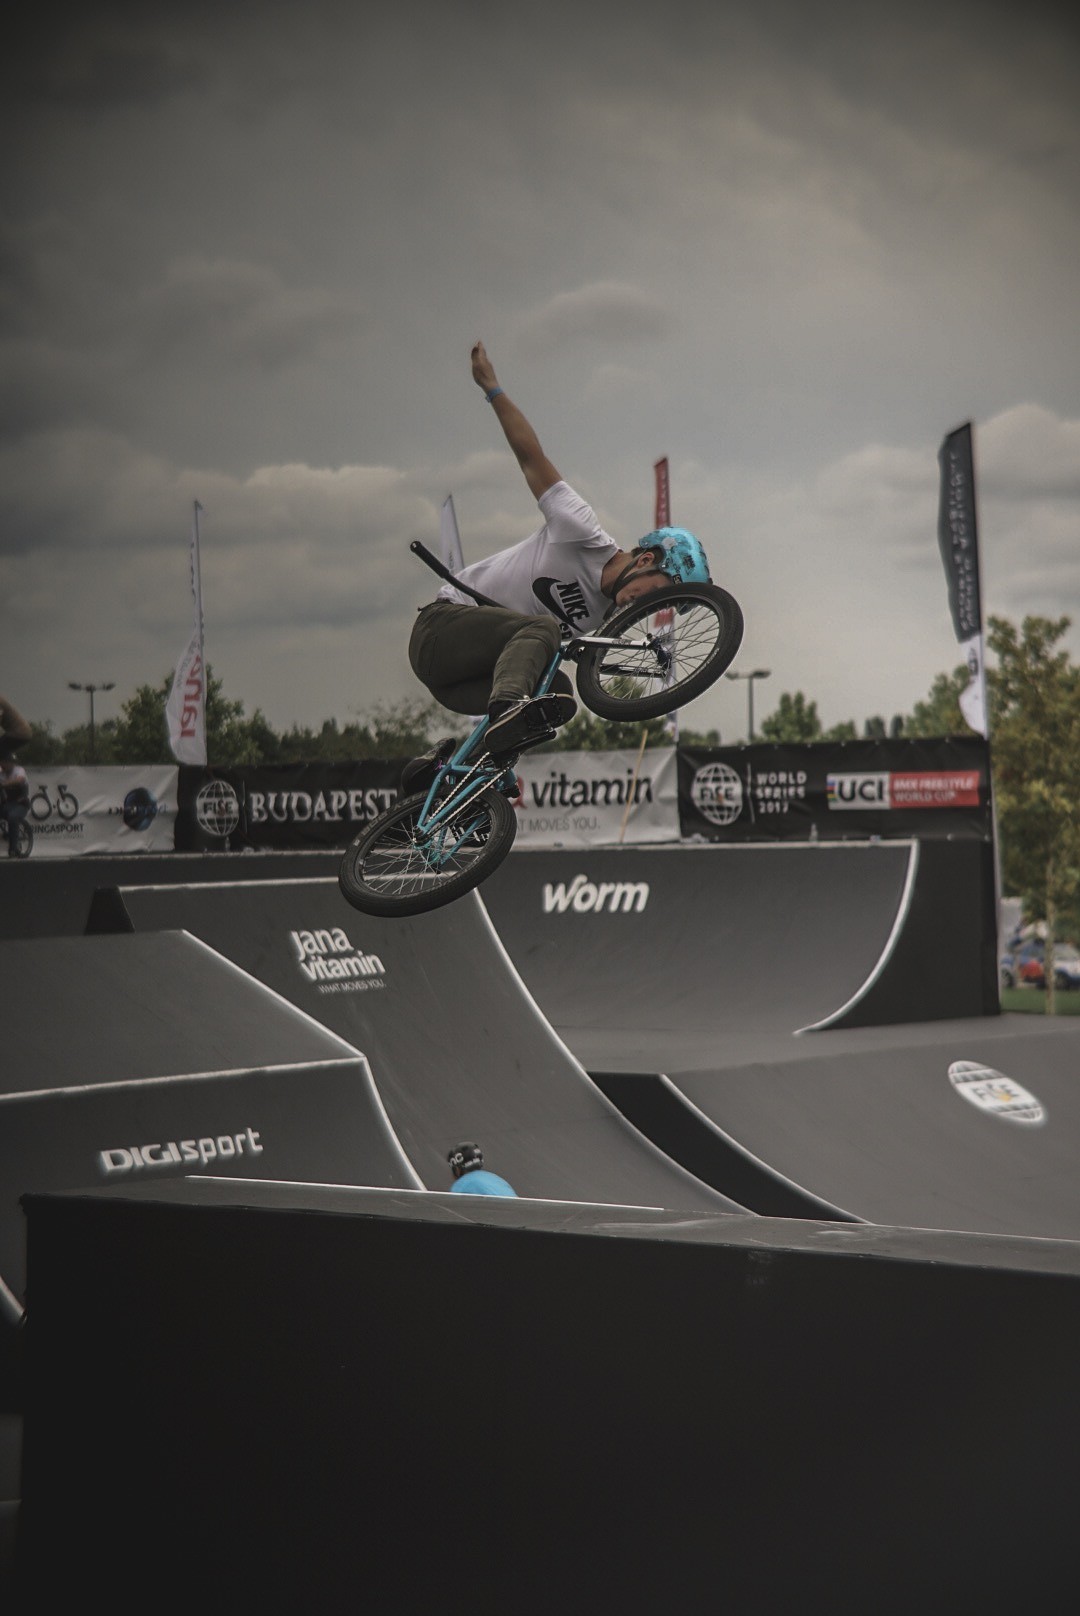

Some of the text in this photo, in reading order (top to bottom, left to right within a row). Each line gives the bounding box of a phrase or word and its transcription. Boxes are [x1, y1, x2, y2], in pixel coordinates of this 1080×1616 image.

[556, 580, 590, 621] NIKE
[756, 770, 808, 785] WORLD
[531, 768, 653, 807] vitamin
[756, 785, 806, 799] SERIES
[838, 778, 884, 801] UCI
[894, 790, 956, 802] WORLD CUP
[203, 800, 233, 816] FISE
[249, 788, 398, 822] BUDAPEST
[758, 801, 789, 814] 2017
[529, 817, 570, 832] MOVES
[573, 816, 600, 830] YOU.
[543, 873, 650, 913] worm
[300, 949, 387, 981] vitamin
[318, 982, 341, 994] WHAT
[340, 980, 368, 992] MOVES
